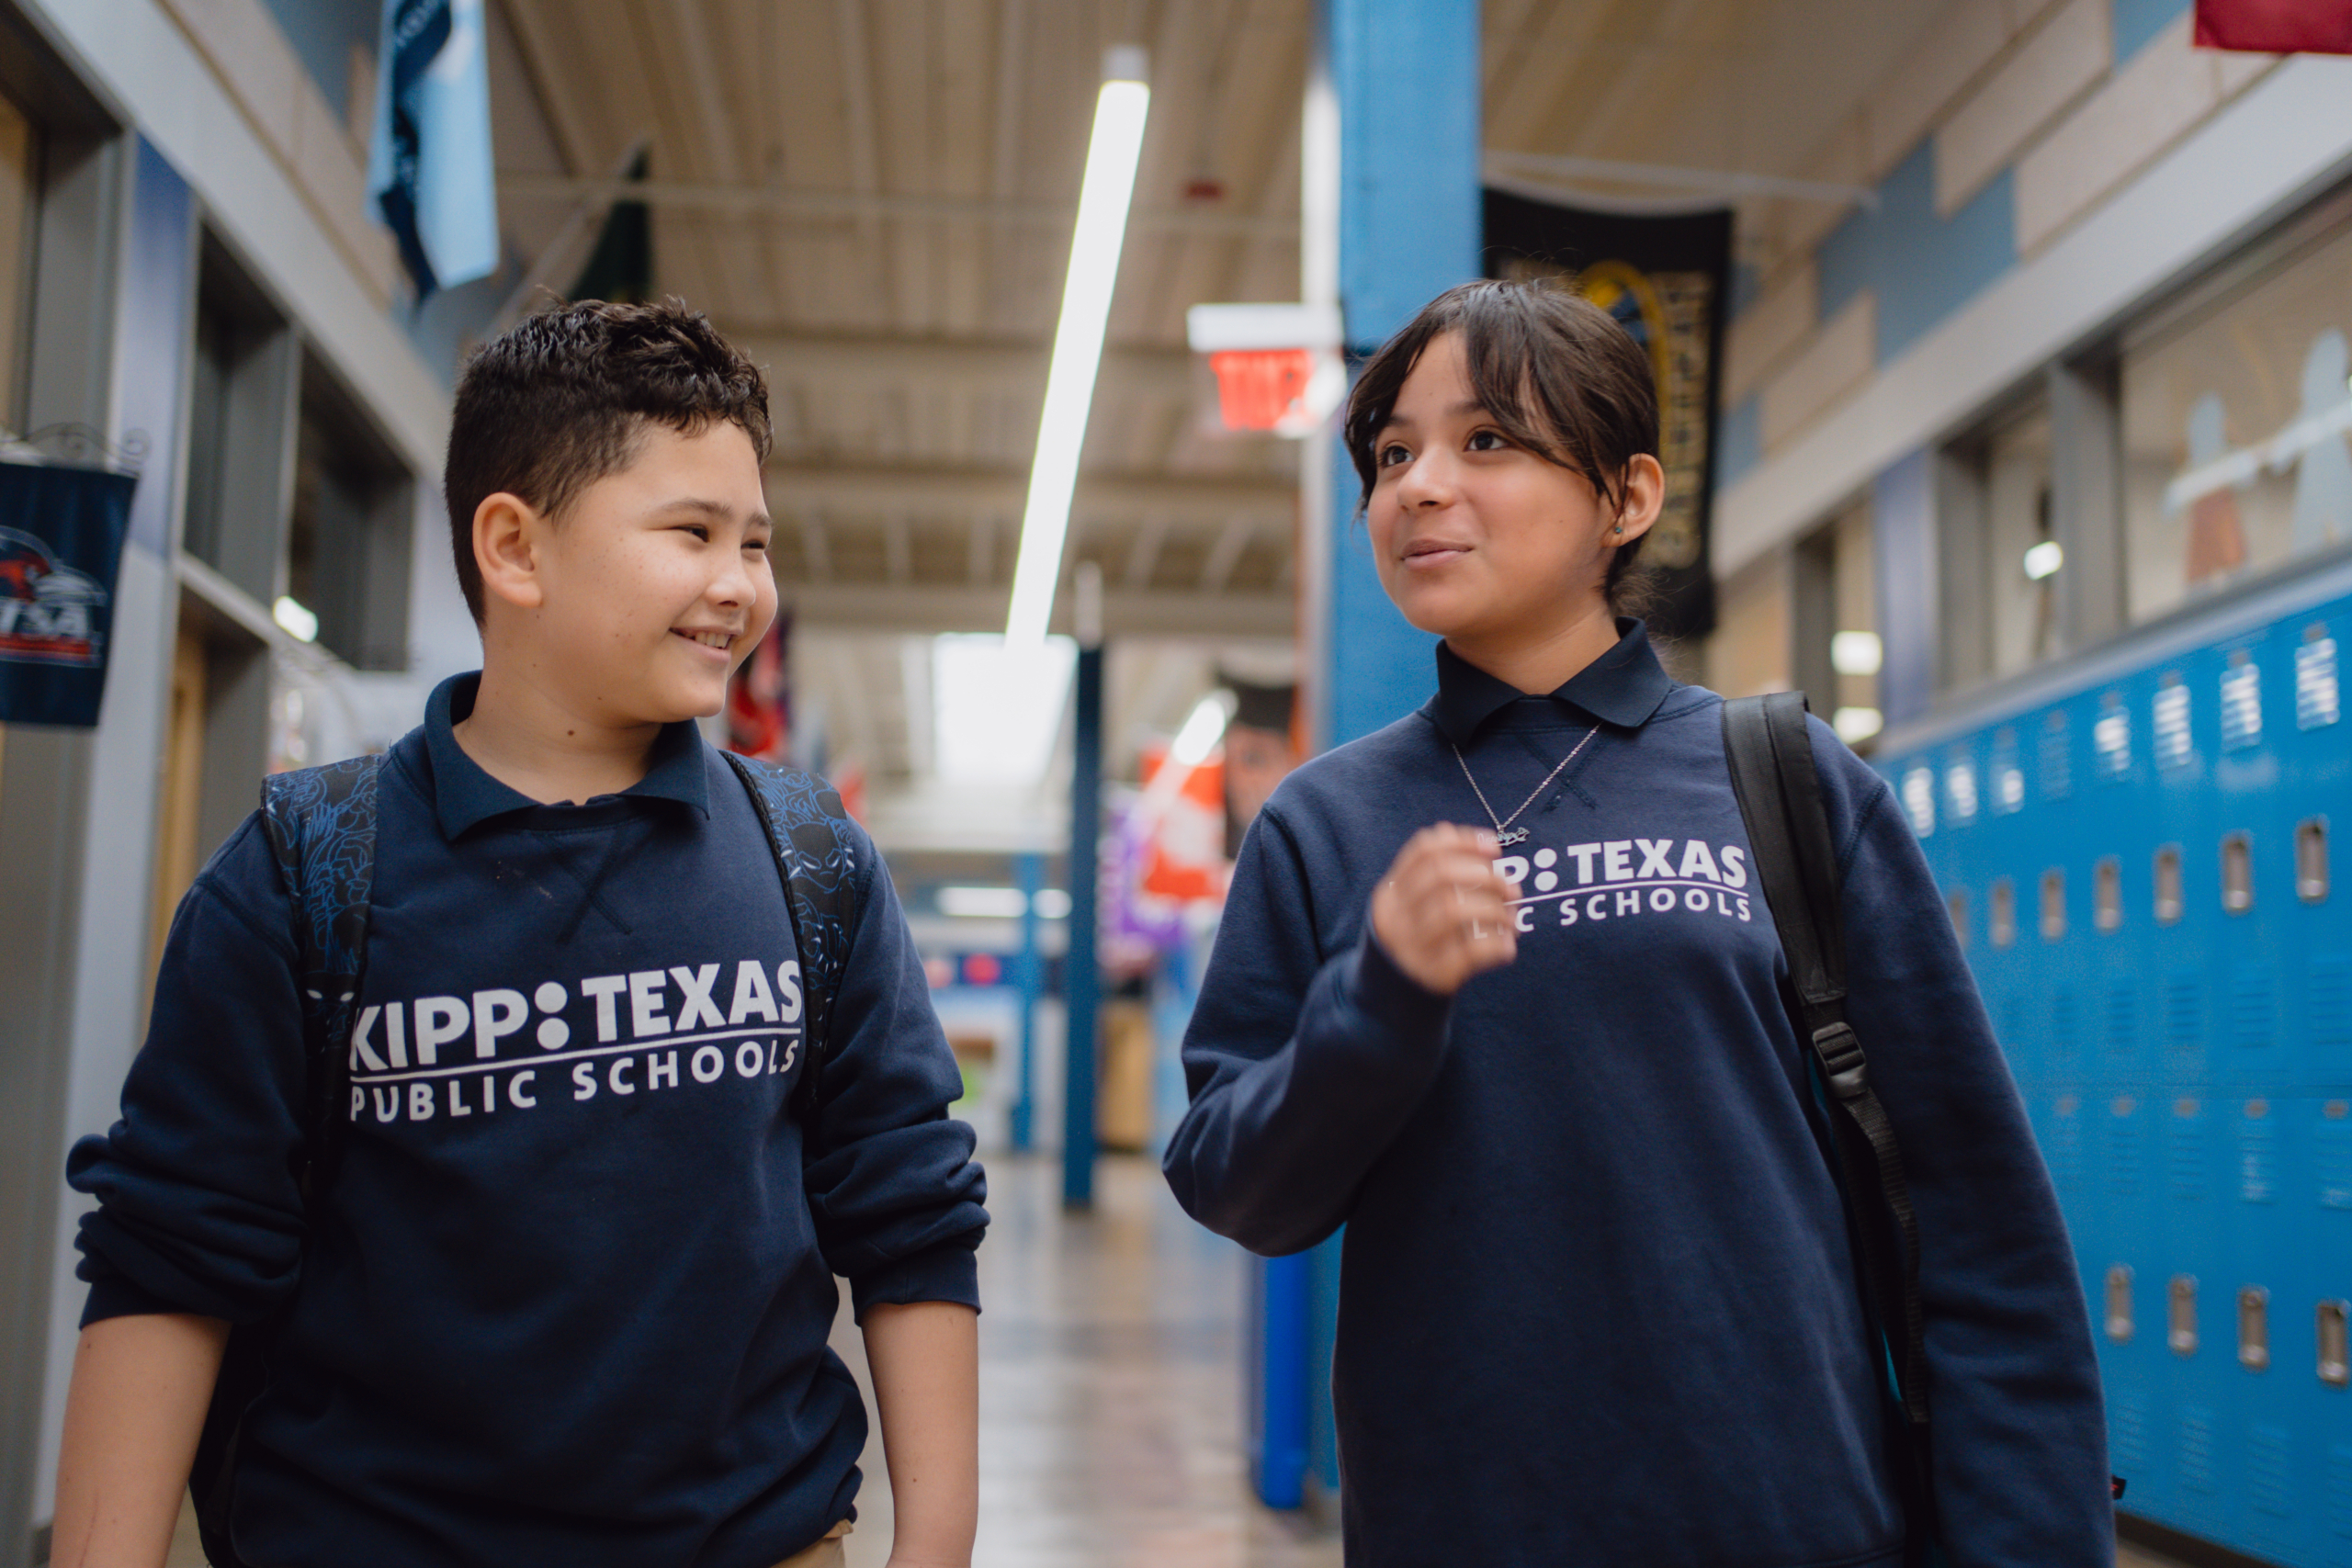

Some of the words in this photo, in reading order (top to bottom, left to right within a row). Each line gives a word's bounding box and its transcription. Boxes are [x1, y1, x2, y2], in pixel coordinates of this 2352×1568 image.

[1566, 838, 1747, 889] TEXAS
[1559, 887, 1751, 926] SCHOOLS
[581, 958, 803, 1043] TEXAS
[349, 1070, 537, 1123] PUBLIC
[571, 1038, 800, 1101] SCHOOLS
